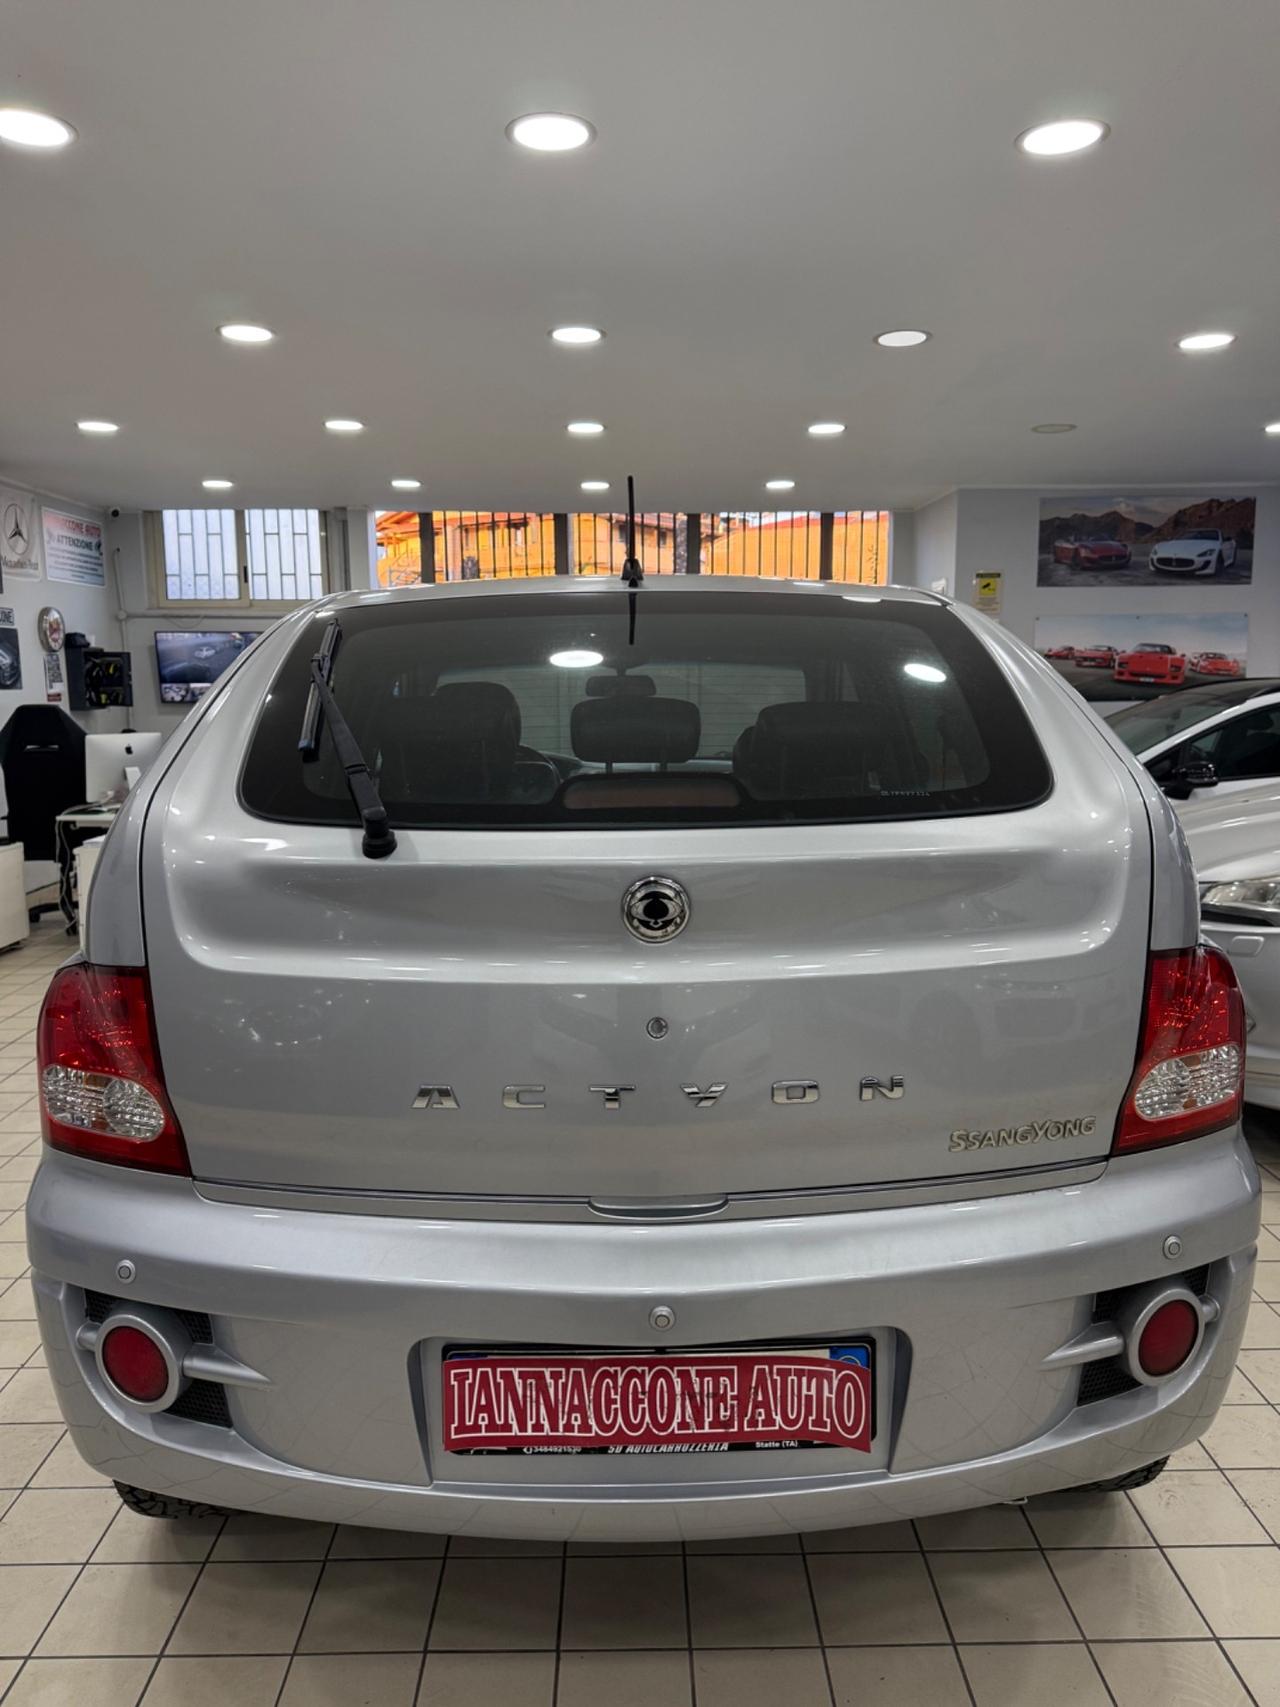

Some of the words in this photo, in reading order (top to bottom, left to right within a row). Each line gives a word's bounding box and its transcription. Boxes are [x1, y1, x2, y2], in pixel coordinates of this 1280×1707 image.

[414, 1075, 904, 1110] ACTYON
[949, 1115, 1096, 1152] SSANGYONG
[450, 1365, 738, 1439] IANNACCONE
[743, 1364, 866, 1439] AUTO
